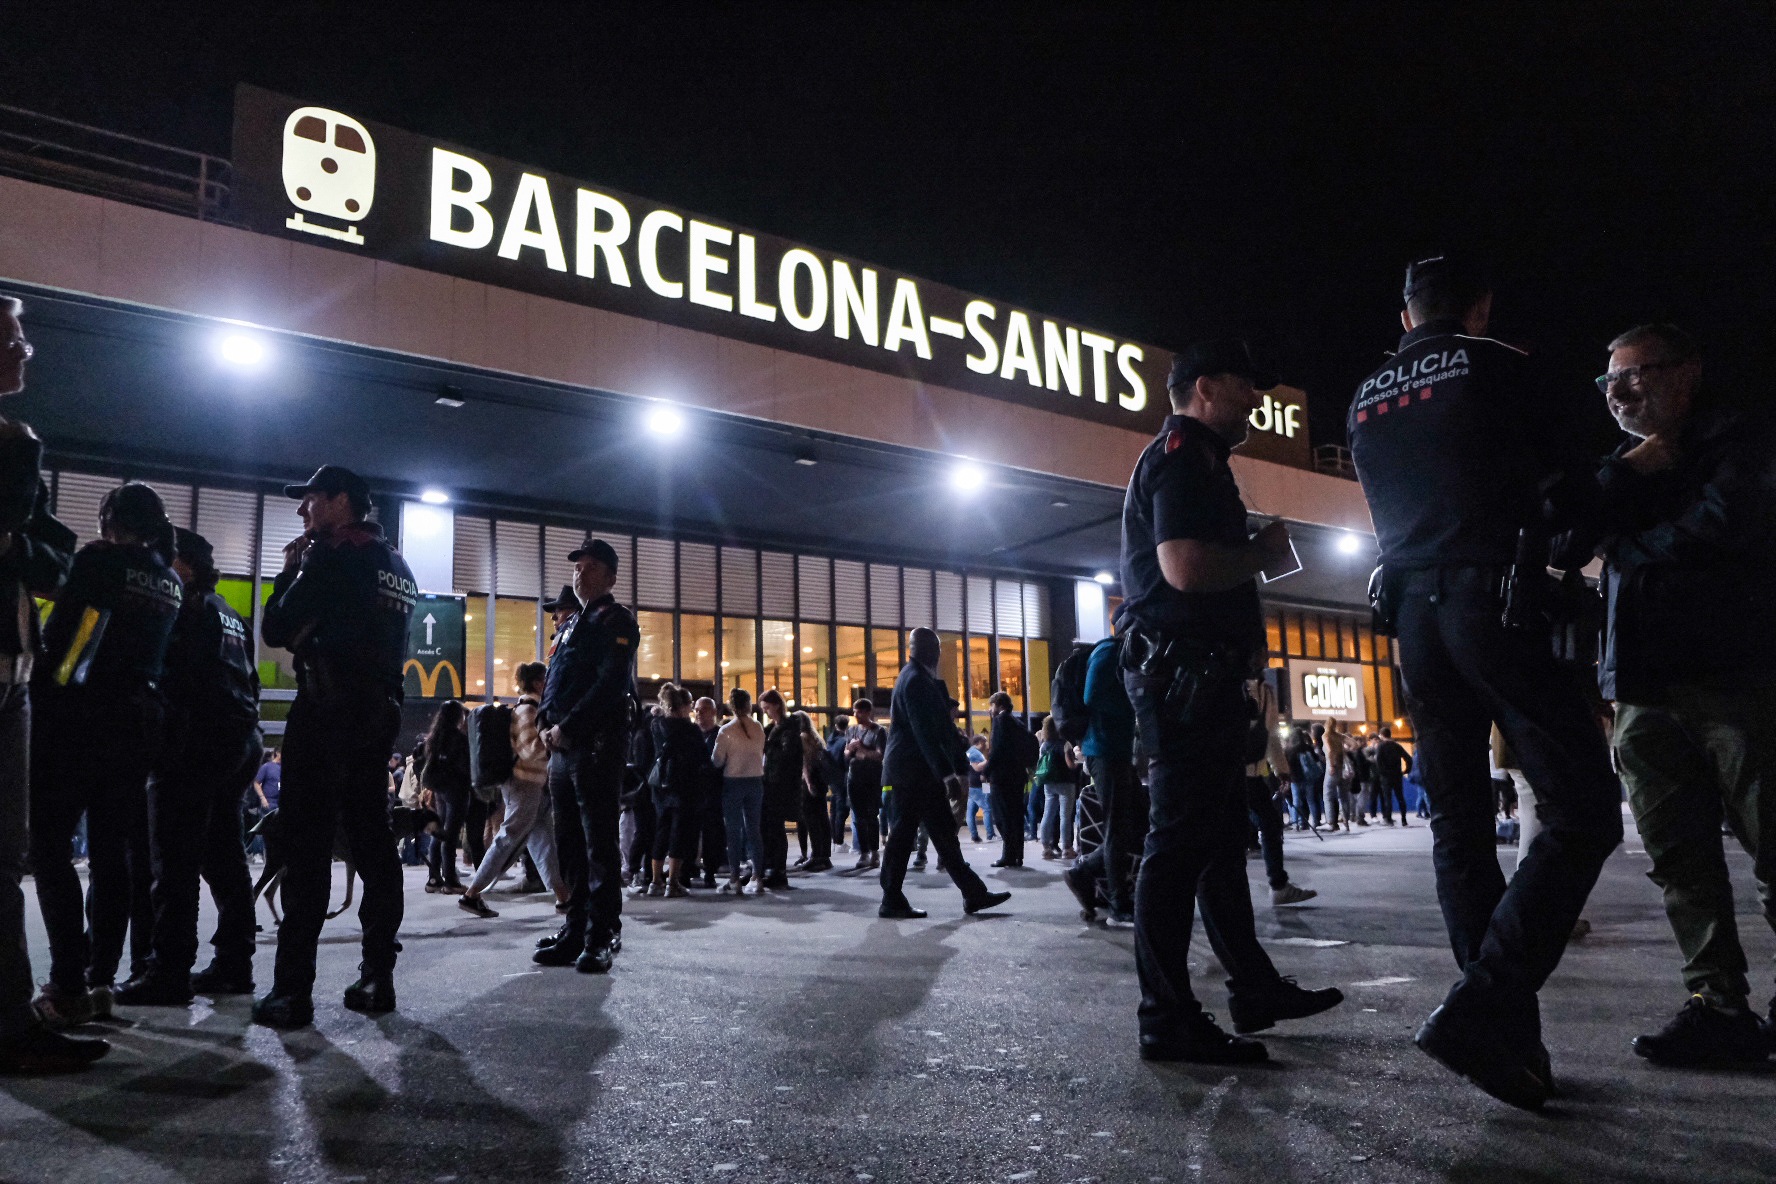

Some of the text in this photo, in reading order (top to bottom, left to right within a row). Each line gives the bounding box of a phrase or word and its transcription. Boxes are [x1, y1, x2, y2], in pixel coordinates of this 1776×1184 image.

[430, 147, 1147, 411] BARCELONA-SANTS
[1357, 367, 1470, 410] mossos d'esquadra
[1360, 349, 1470, 398] POLICIA
[126, 568, 183, 601] POLICIA
[377, 569, 418, 598] POLICIA
[435, 646, 442, 655] C
[1304, 674, 1358, 709] COMO
